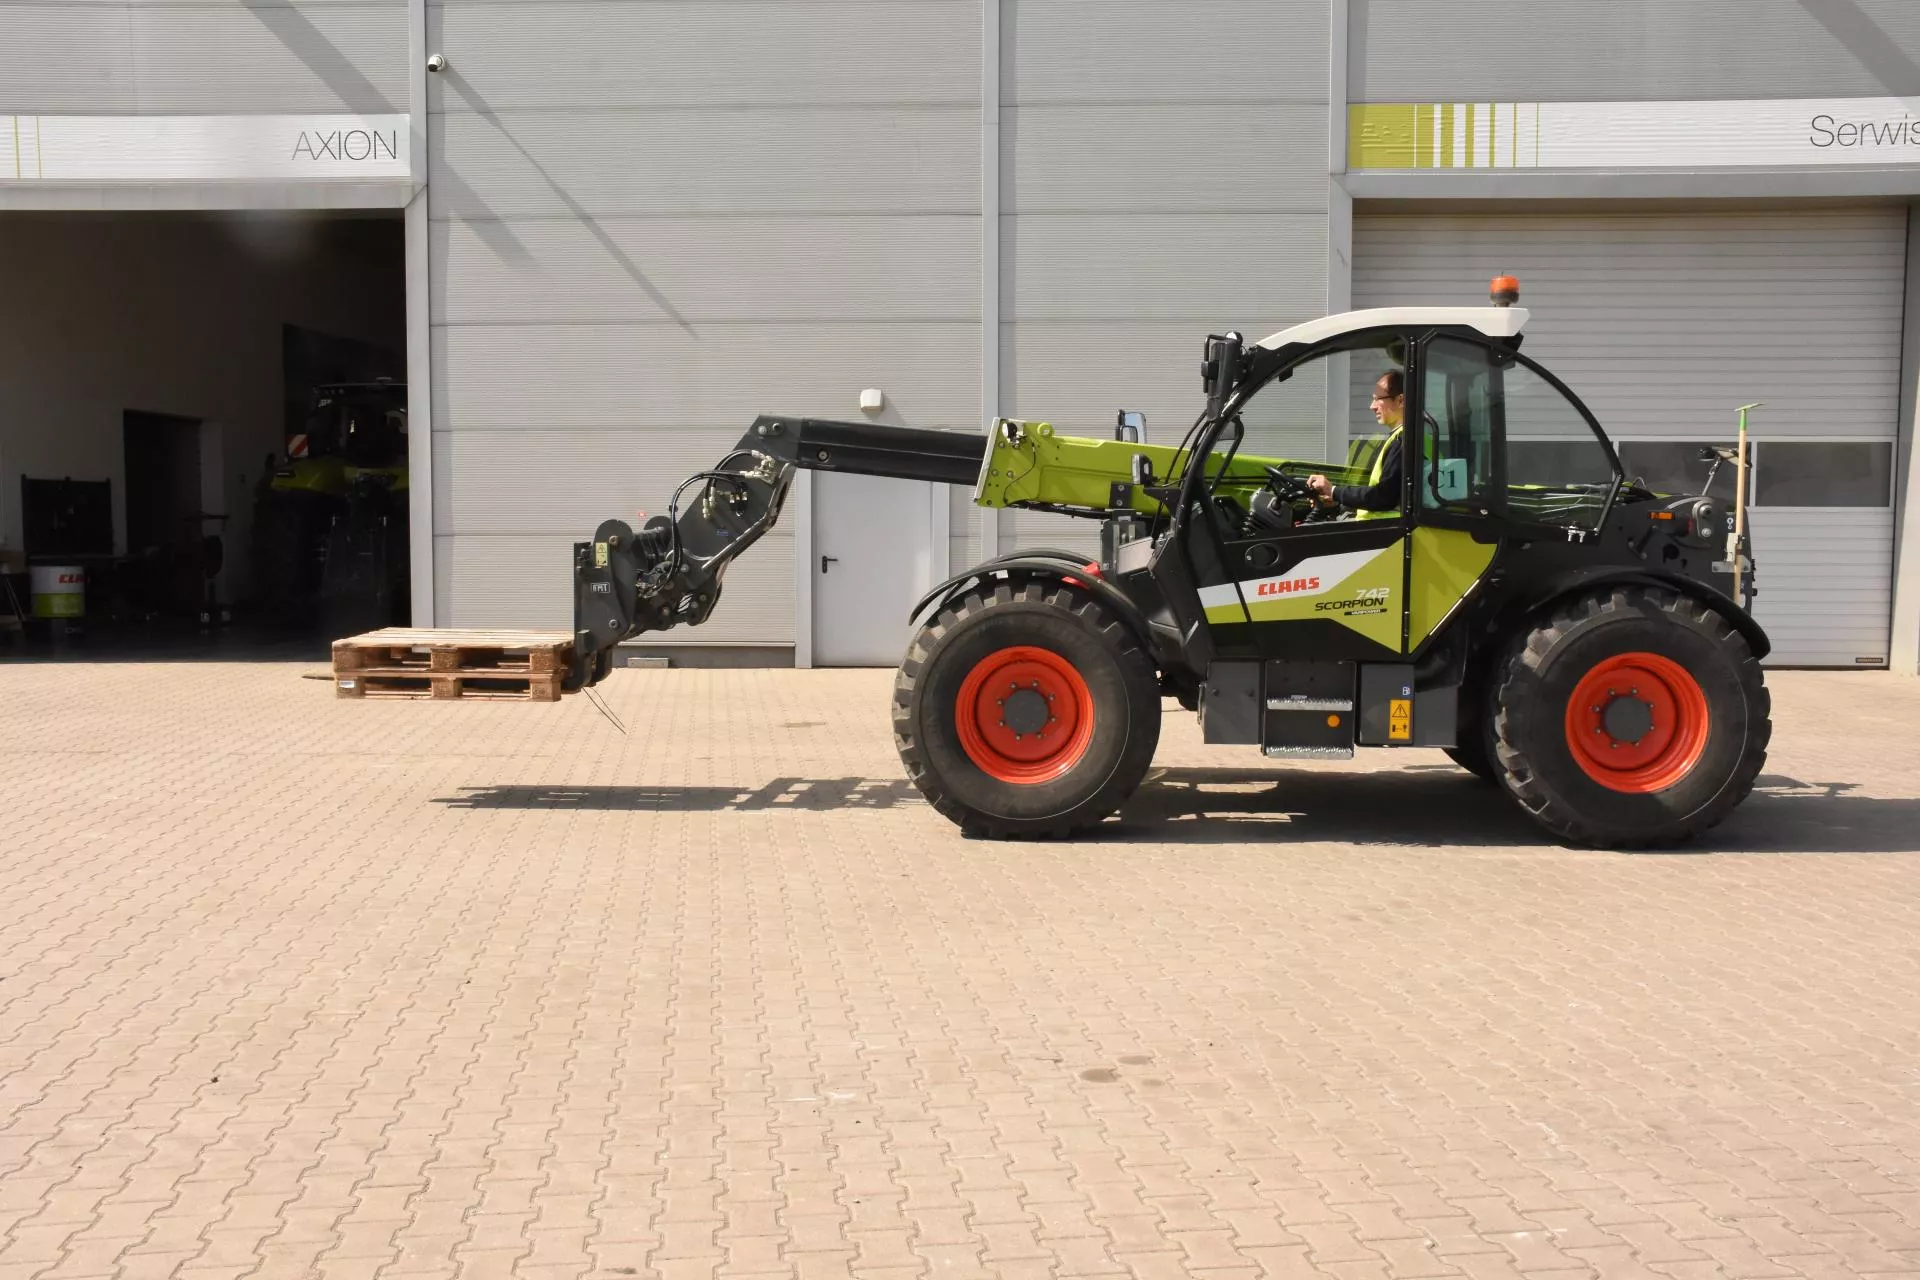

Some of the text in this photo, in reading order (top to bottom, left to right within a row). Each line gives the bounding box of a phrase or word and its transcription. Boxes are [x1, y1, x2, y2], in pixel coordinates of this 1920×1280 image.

[1809, 112, 1920, 147] Serwis
[291, 129, 397, 160] AXION
[1257, 576, 1320, 596] CLAAS
[1355, 587, 1390, 601] 742
[1314, 598, 1384, 611] SCORPION
